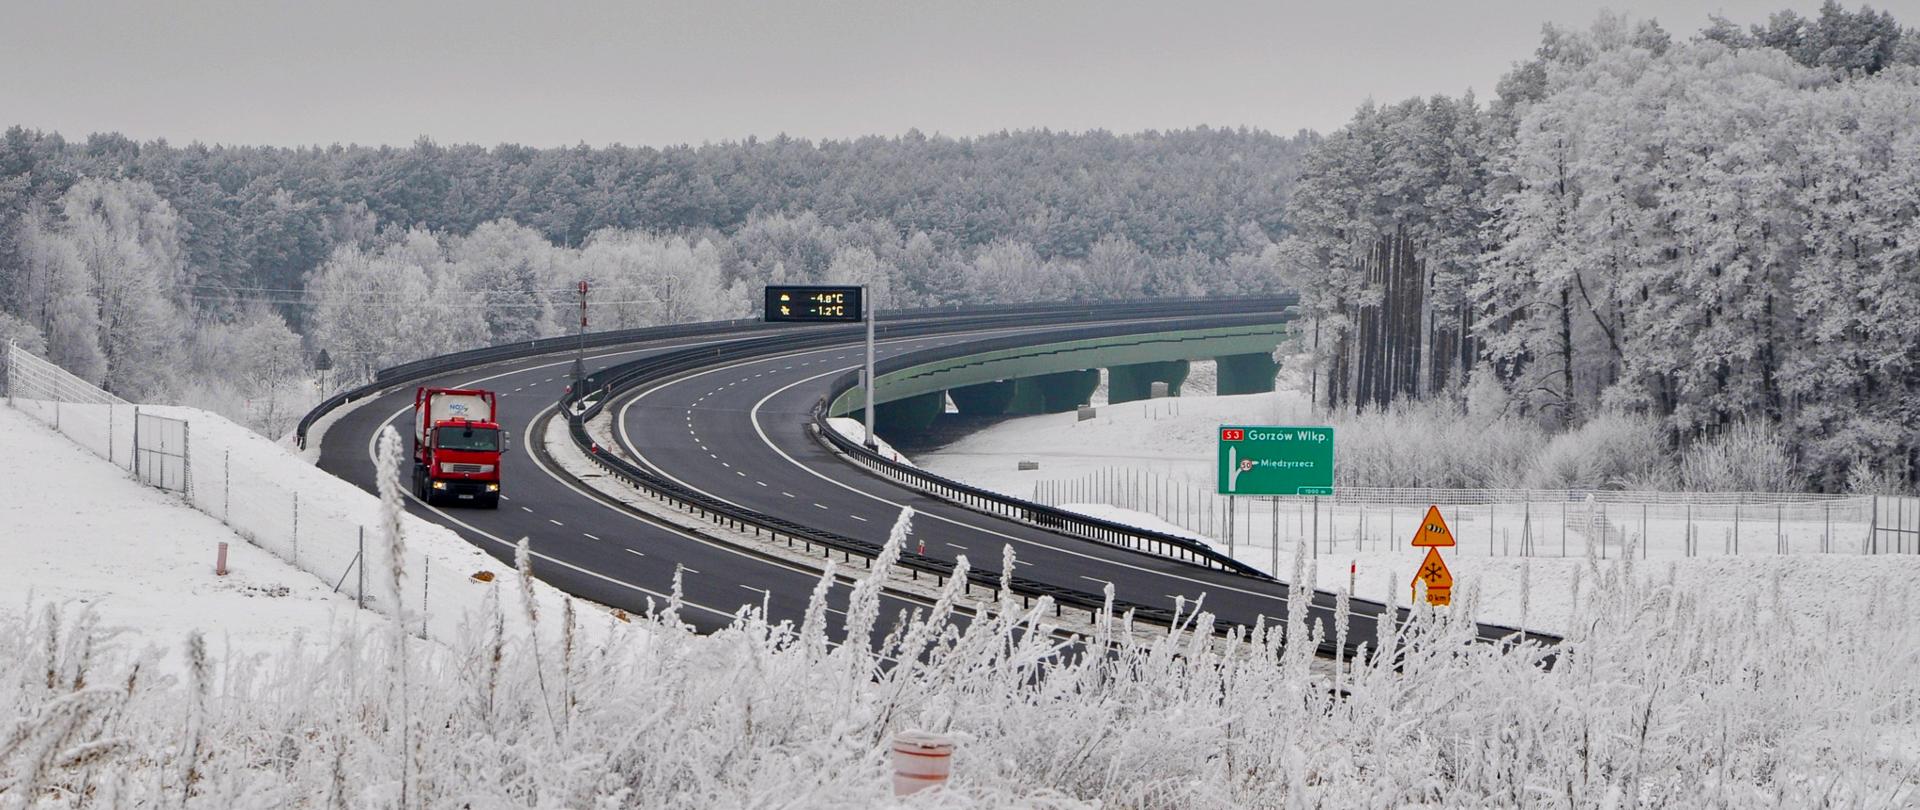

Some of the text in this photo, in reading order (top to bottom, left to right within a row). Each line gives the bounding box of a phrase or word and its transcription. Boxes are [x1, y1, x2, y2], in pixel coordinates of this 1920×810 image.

[1248, 430, 1329, 443] Gorzów Wlkp.
[1260, 459, 1314, 469] Międzyrzecz
